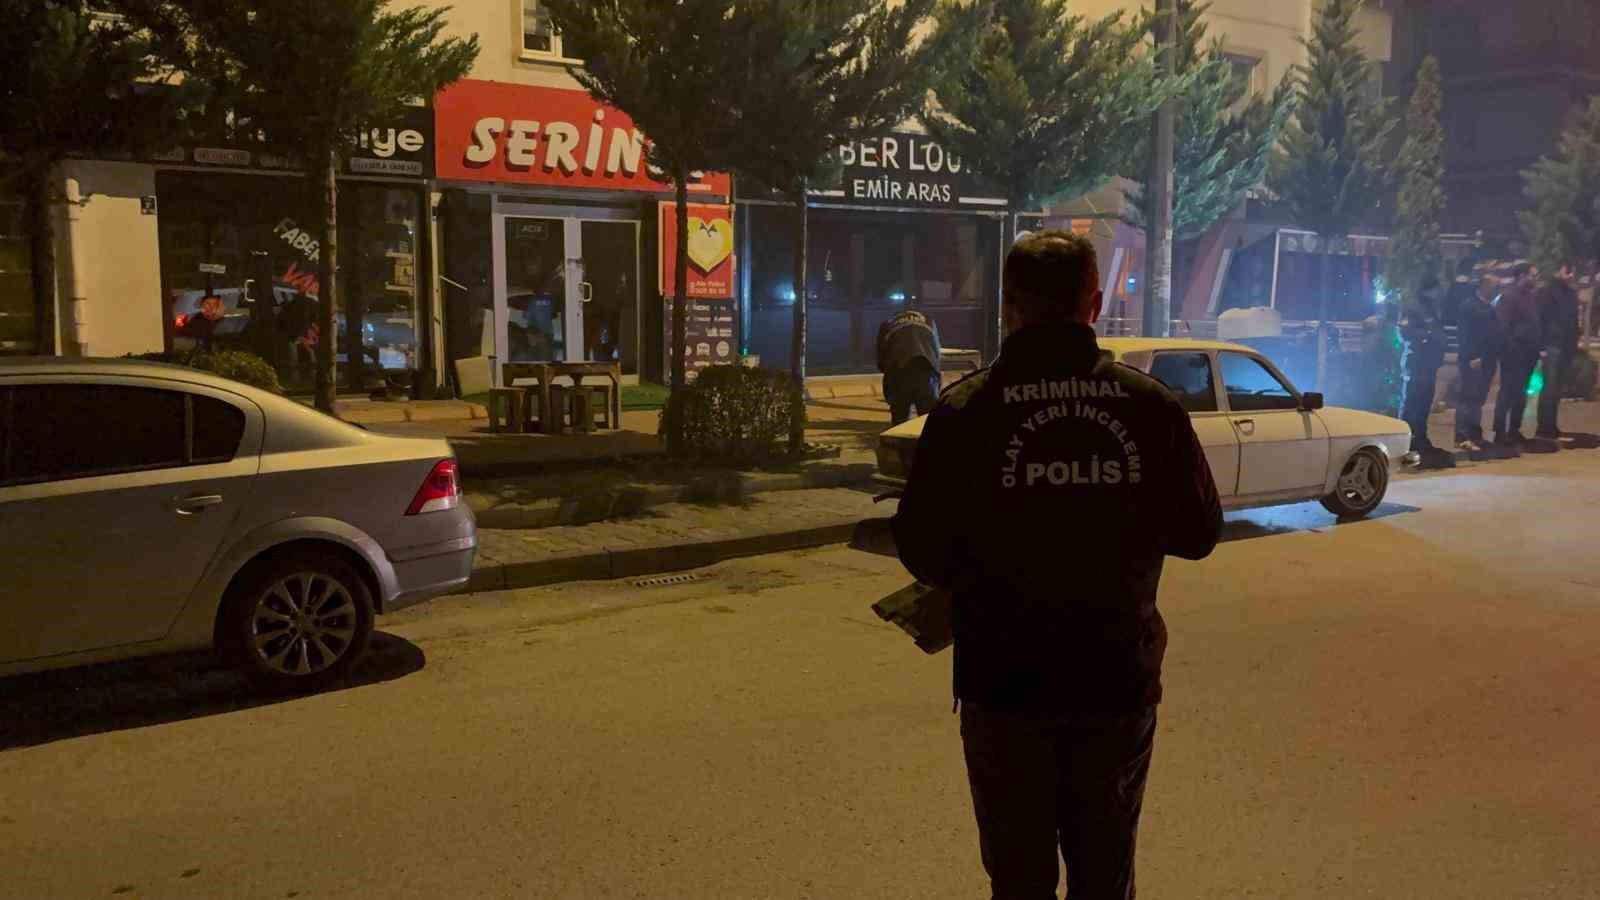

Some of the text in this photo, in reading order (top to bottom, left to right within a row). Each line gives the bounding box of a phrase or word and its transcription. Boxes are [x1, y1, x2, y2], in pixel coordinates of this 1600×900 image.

[466, 109, 664, 177] SERİN
[839, 137, 972, 174] BER LOU
[853, 174, 951, 202] EMİR ARAS
[1003, 376, 1130, 404] KRİMİNAL
[1002, 433, 1024, 488] OLAY
[1021, 401, 1068, 432] YERİ
[1026, 453, 1123, 486] POLİS
